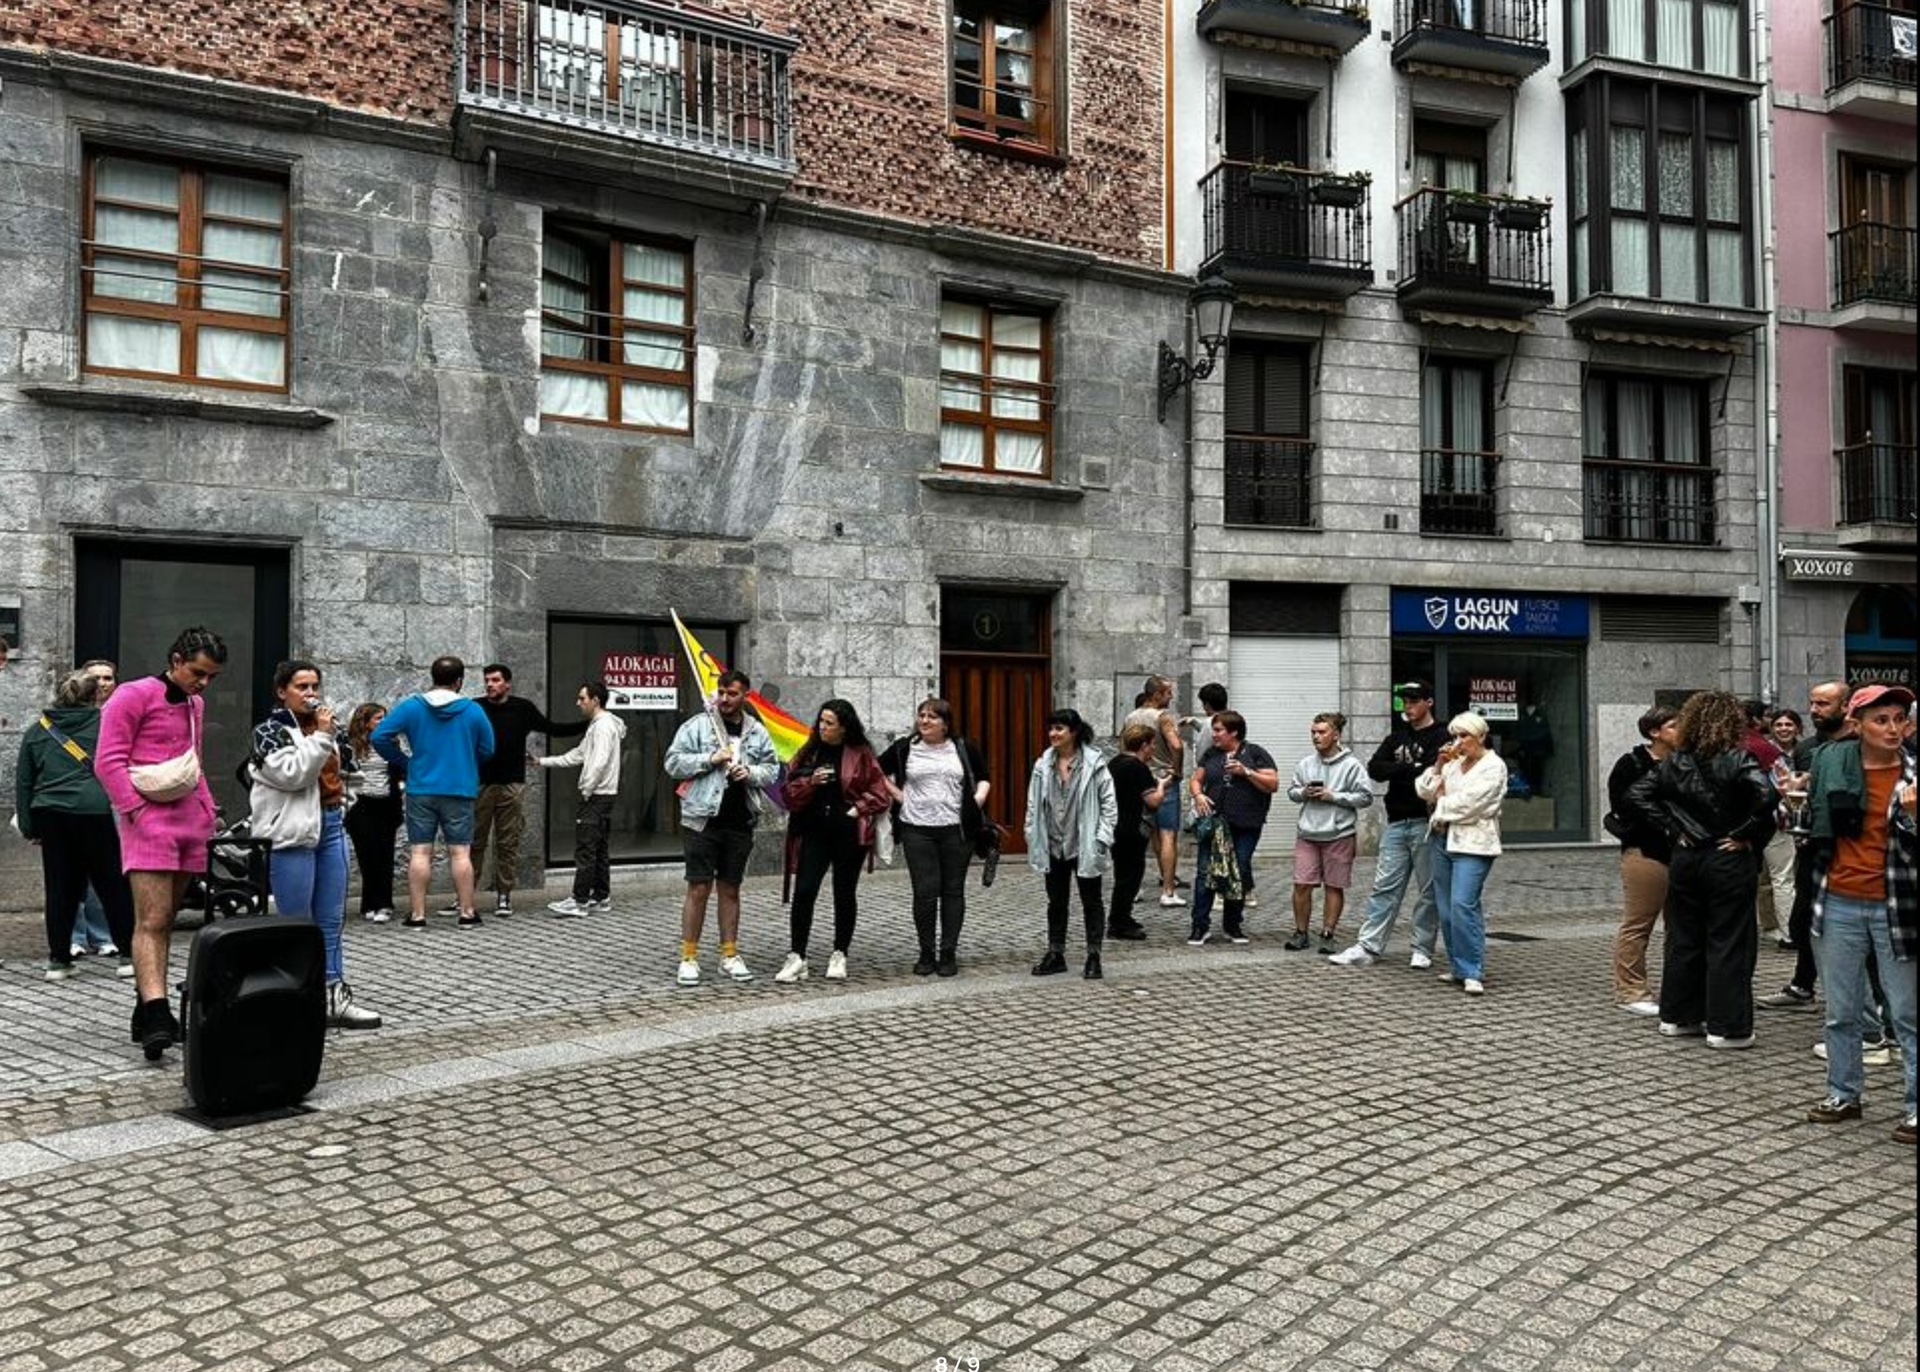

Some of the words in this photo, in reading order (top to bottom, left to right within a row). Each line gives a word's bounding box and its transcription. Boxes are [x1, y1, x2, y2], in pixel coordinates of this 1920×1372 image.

[1454, 597, 1519, 615] LAGUN
[1454, 614, 1510, 632] ONAK
[605, 655, 675, 672] ALOKAGAI
[604, 674, 626, 686] 943
[628, 674, 641, 686] 81
[645, 675, 659, 687] 21
[661, 675, 676, 687] 67
